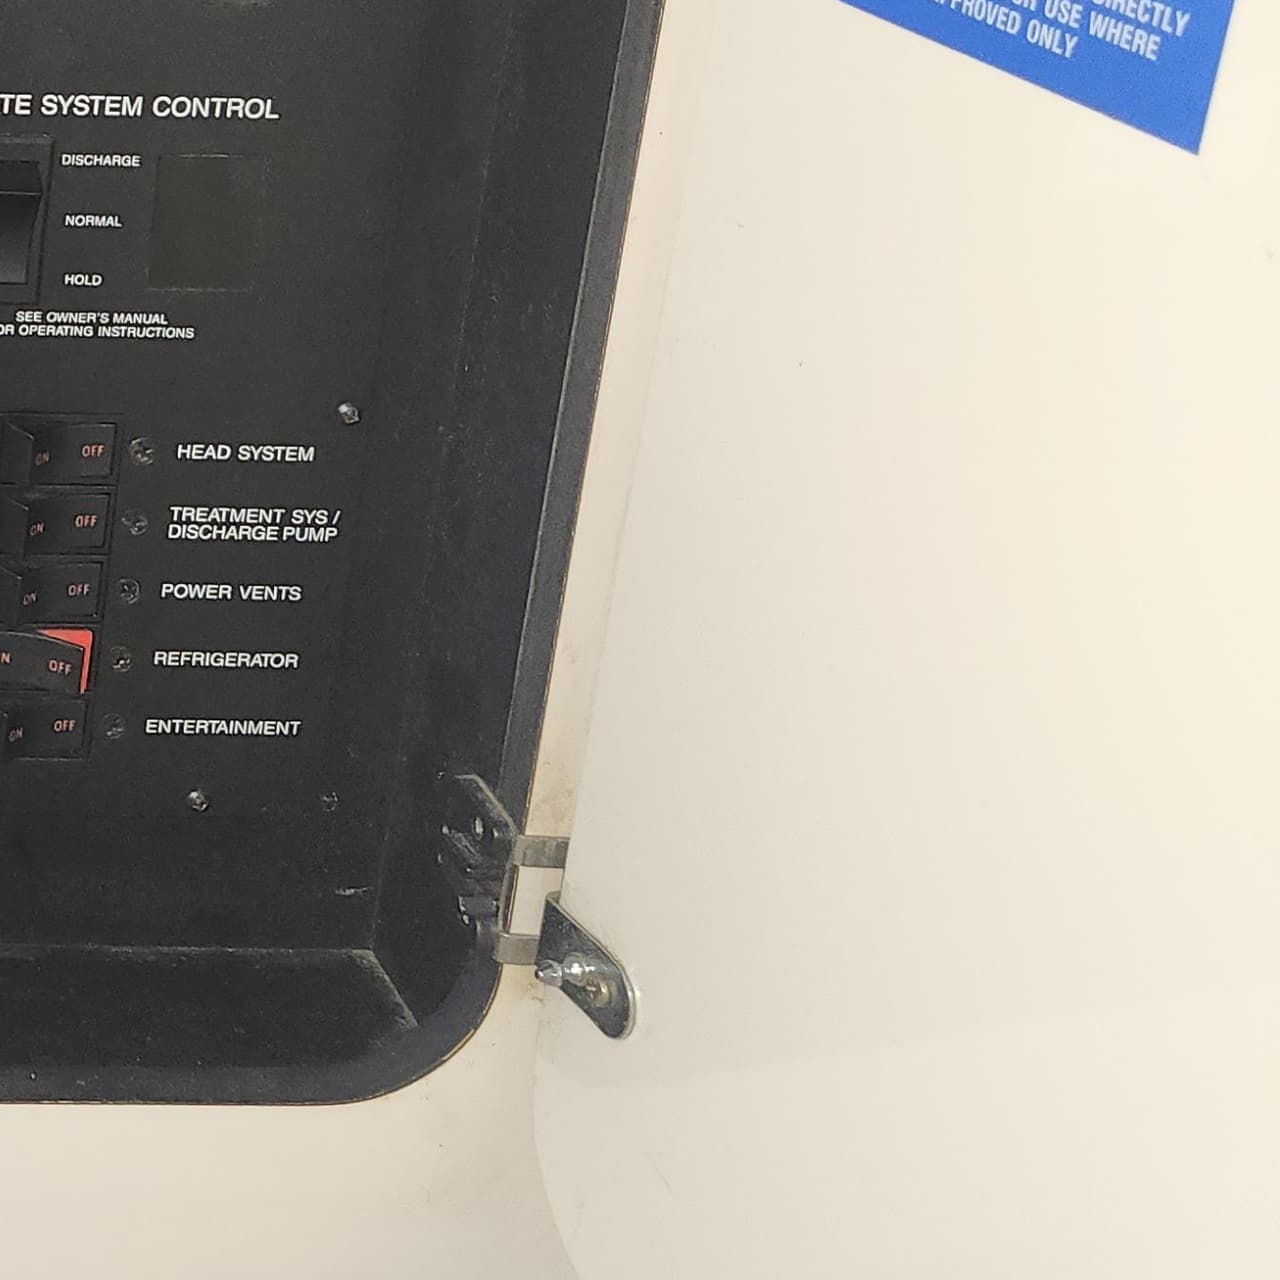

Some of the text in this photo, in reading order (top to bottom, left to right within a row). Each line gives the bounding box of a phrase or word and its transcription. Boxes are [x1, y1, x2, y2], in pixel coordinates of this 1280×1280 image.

[1026, 19, 1080, 60] ONLY
[1088, 12, 1161, 61] WHERE
[41, 95, 142, 116] SYSTEM
[153, 97, 278, 118] CONTROL
[62, 154, 140, 166] DISCHARGE
[65, 215, 121, 226] NORMAL
[65, 275, 101, 285] HOLD
[16, 311, 167, 324] SEE OWNER'S MANUAL
[19, 325, 93, 336] OPERATING
[98, 326, 194, 338] INSTRUCTIONS
[178, 445, 314, 461] HEAD SYSTEM
[171, 507, 328, 524] TREATMENT SYS
[169, 525, 337, 541] DISCHARGE PUMP
[162, 584, 301, 600] POWER VENTS
[49, 660, 70, 674] OFF
[154, 652, 298, 667] REFRIGERATOR
[146, 720, 301, 734] ENTERTAINMENT
